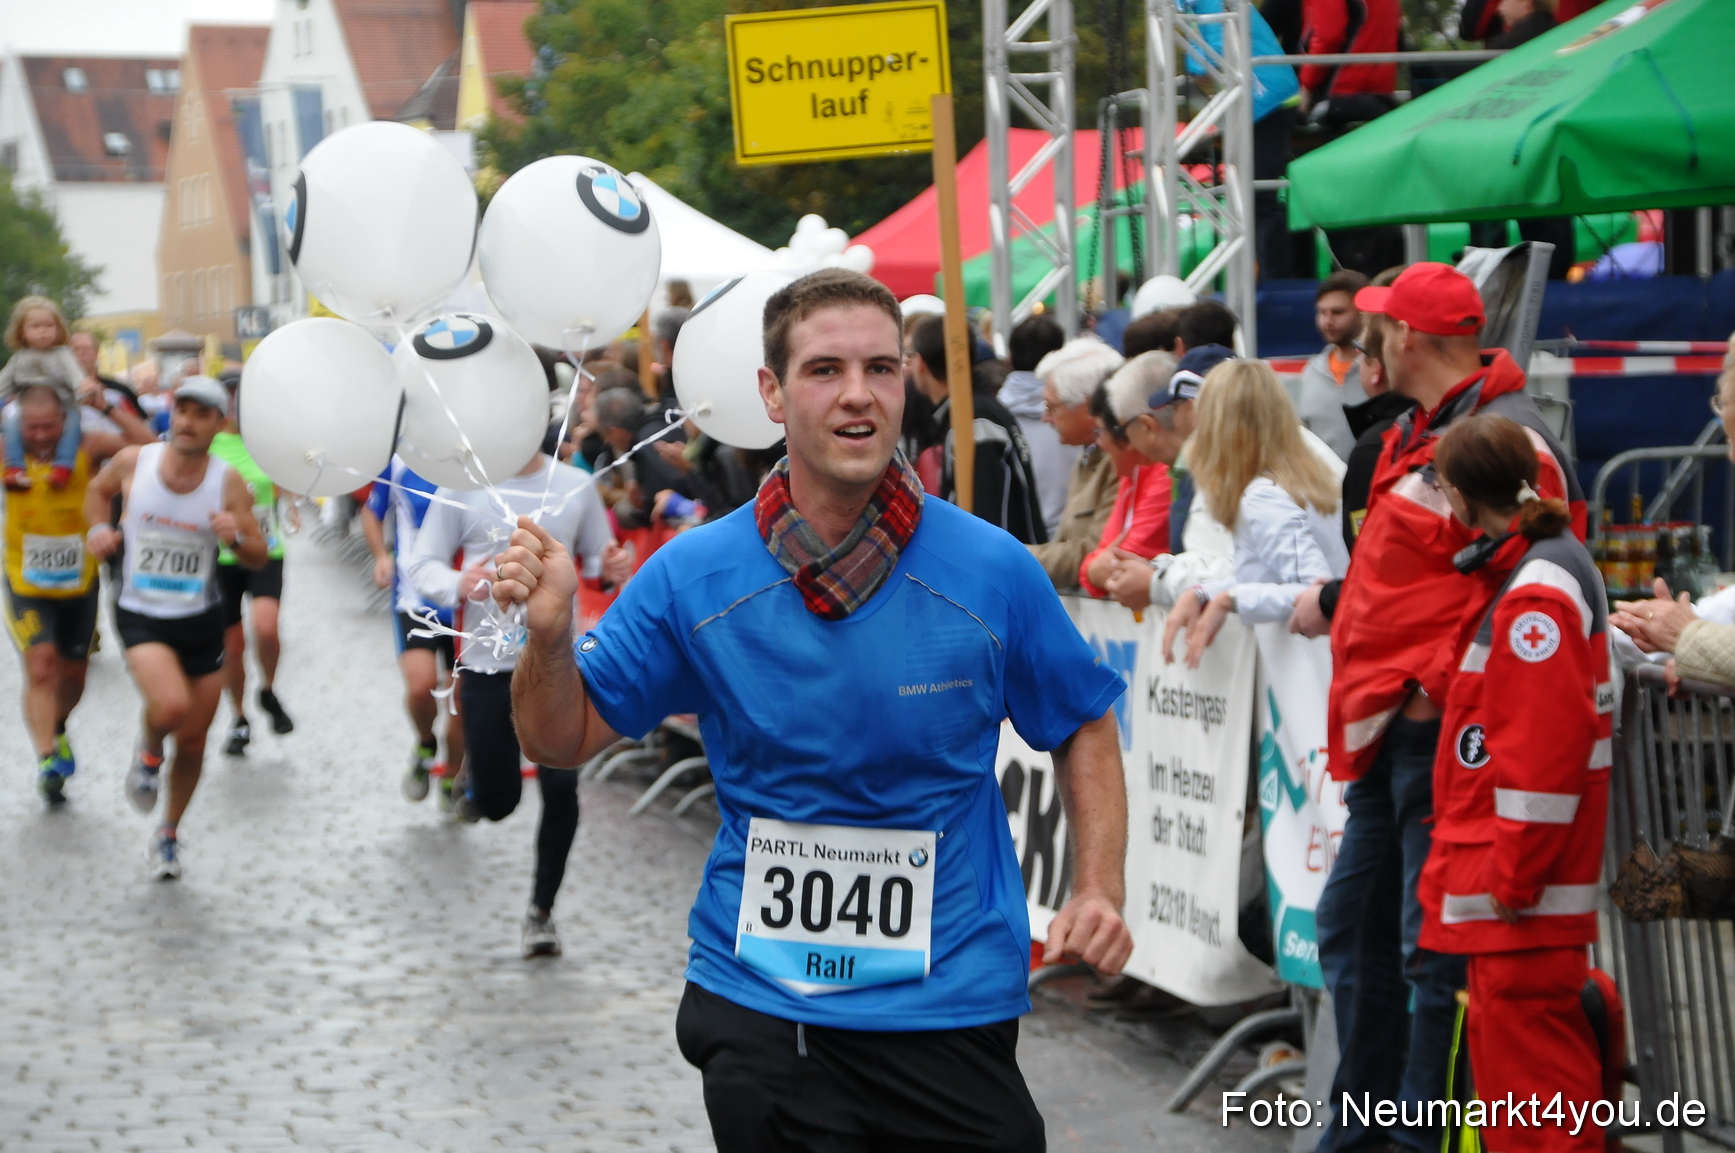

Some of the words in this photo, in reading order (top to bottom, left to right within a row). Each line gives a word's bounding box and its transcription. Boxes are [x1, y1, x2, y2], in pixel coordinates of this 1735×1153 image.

[745, 51, 929, 84] Schnupper-
[811, 88, 869, 119] lauf
[138, 546, 200, 575] 2700
[898, 683, 928, 697] BMW
[929, 678, 974, 694] Athletics
[750, 836, 810, 859] PARTL
[813, 843, 901, 865] Neumarkt
[760, 865, 914, 939] 3040
[806, 952, 856, 980] Ralf
